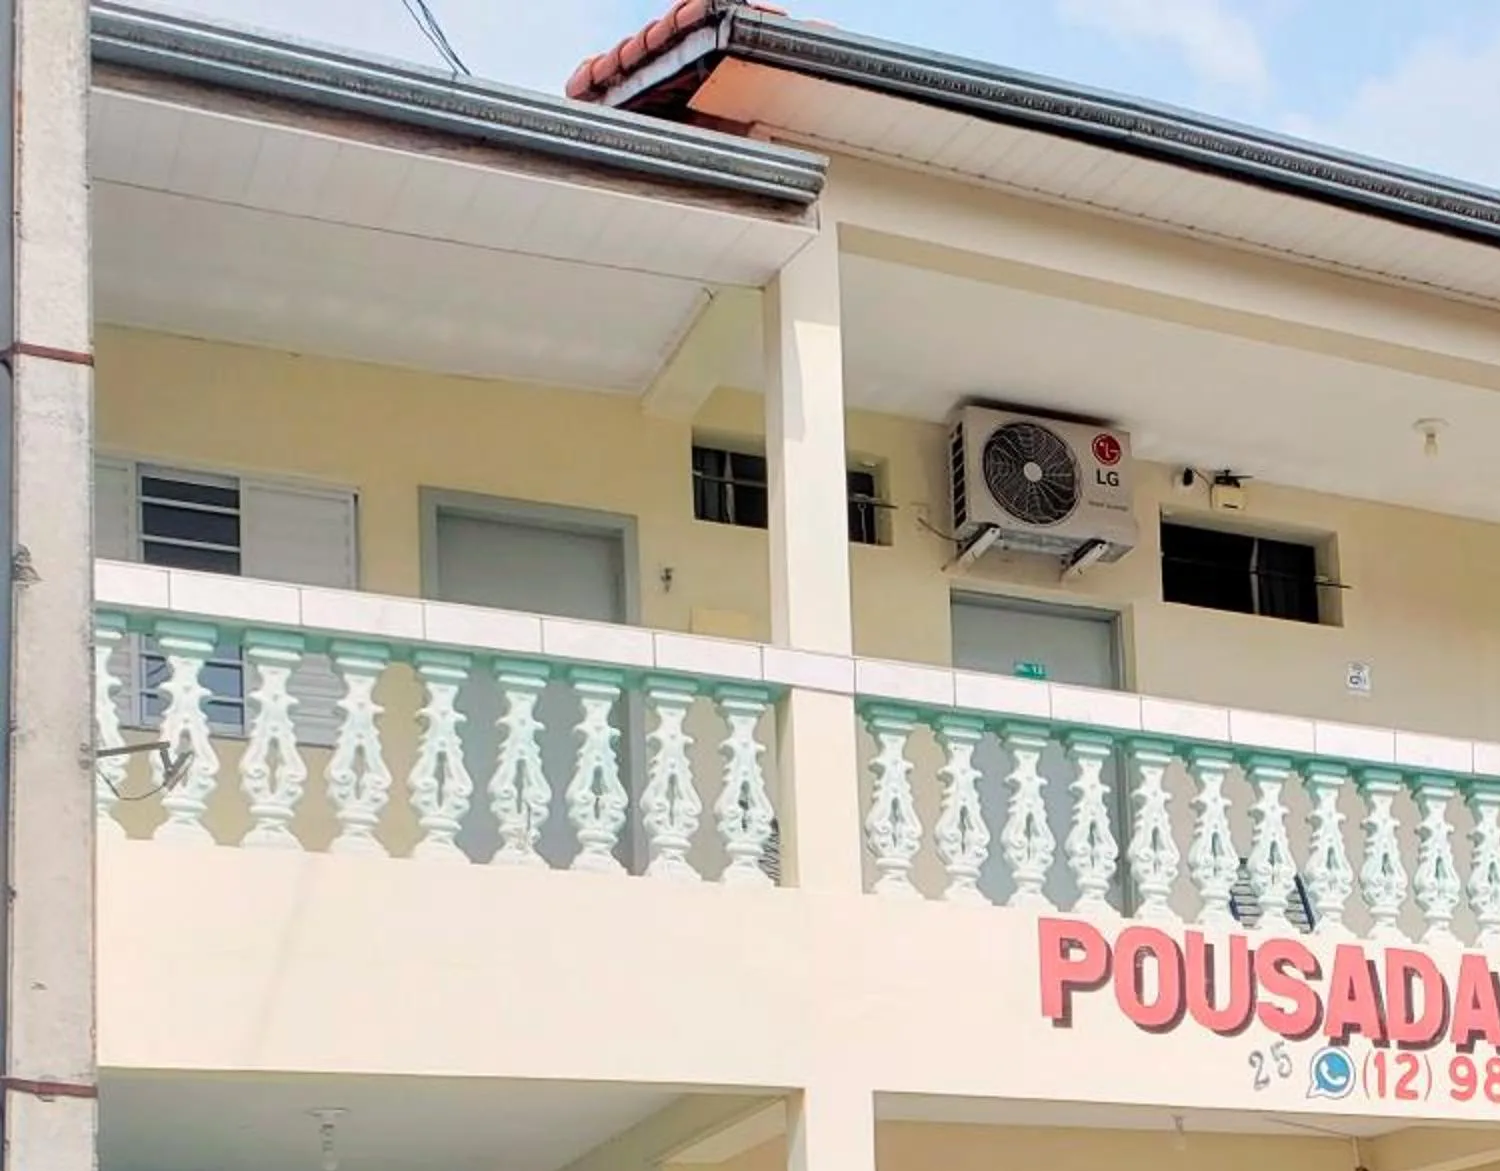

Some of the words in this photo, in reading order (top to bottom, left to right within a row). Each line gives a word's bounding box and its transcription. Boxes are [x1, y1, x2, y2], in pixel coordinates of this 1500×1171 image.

[1096, 469, 1119, 486] LG
[1247, 1042, 1294, 1090] 25
[1361, 1050, 1434, 1101] (12)
